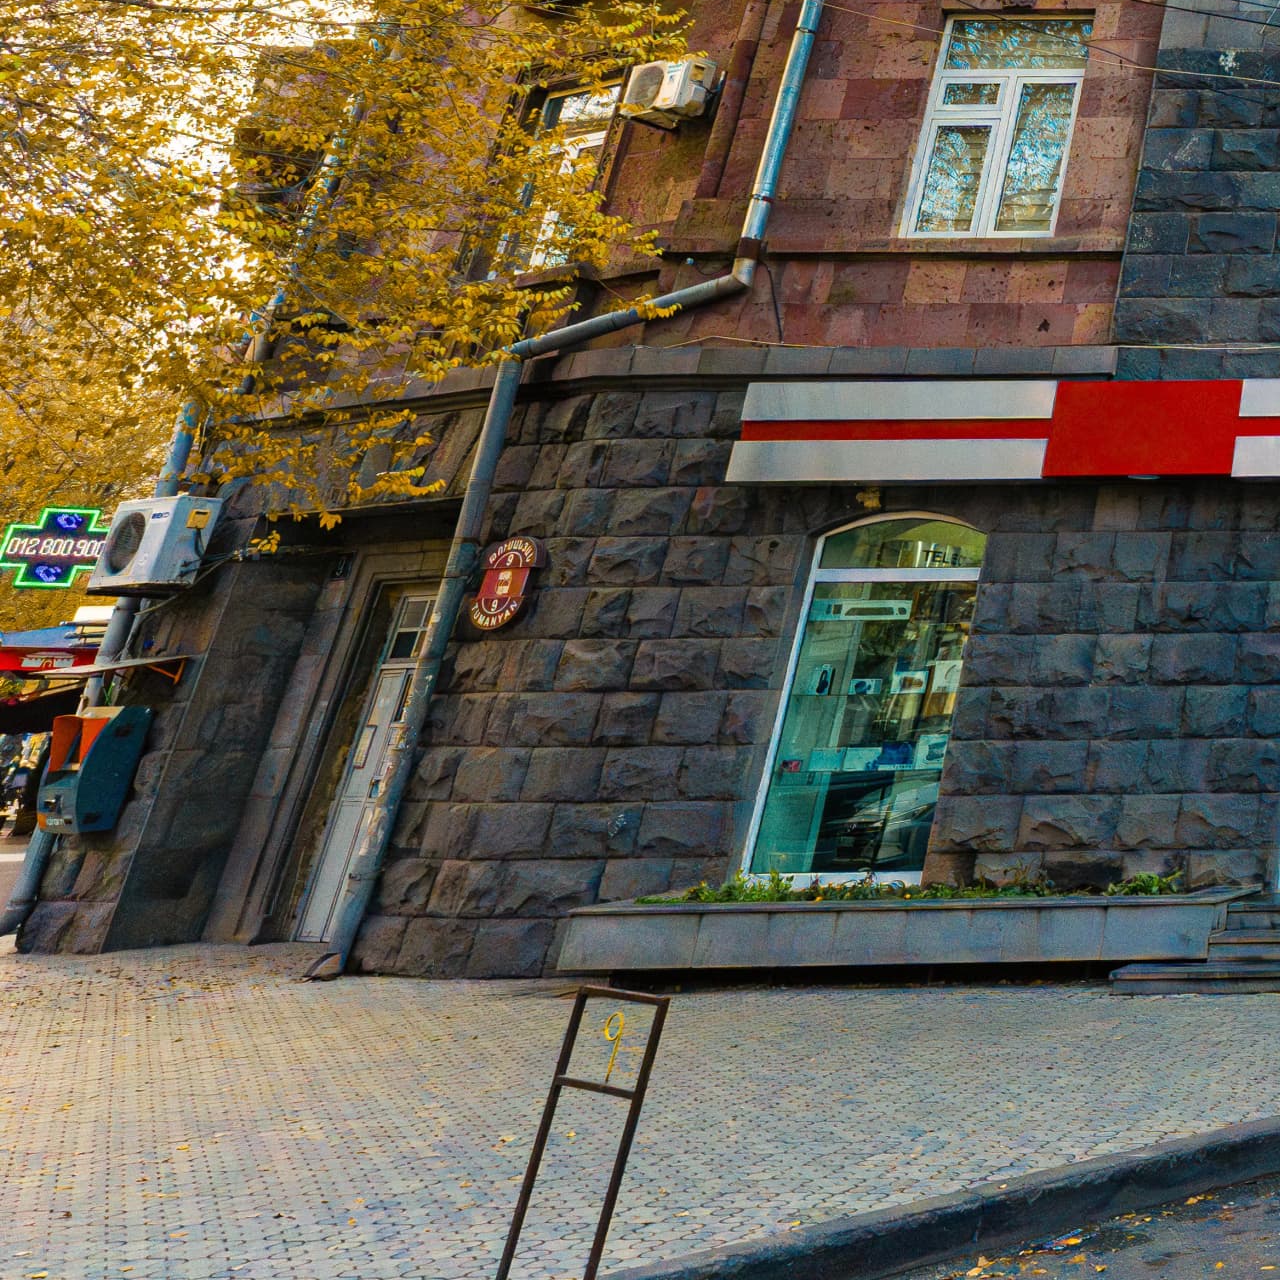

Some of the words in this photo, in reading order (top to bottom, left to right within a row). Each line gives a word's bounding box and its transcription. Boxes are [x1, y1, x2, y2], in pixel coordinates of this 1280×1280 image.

[6, 537, 40, 555] 012
[505, 553, 514, 566] 9
[471, 600, 517, 626] TUMANYAN
[490, 599, 499, 612] 9
[604, 1012, 625, 1084] 9
